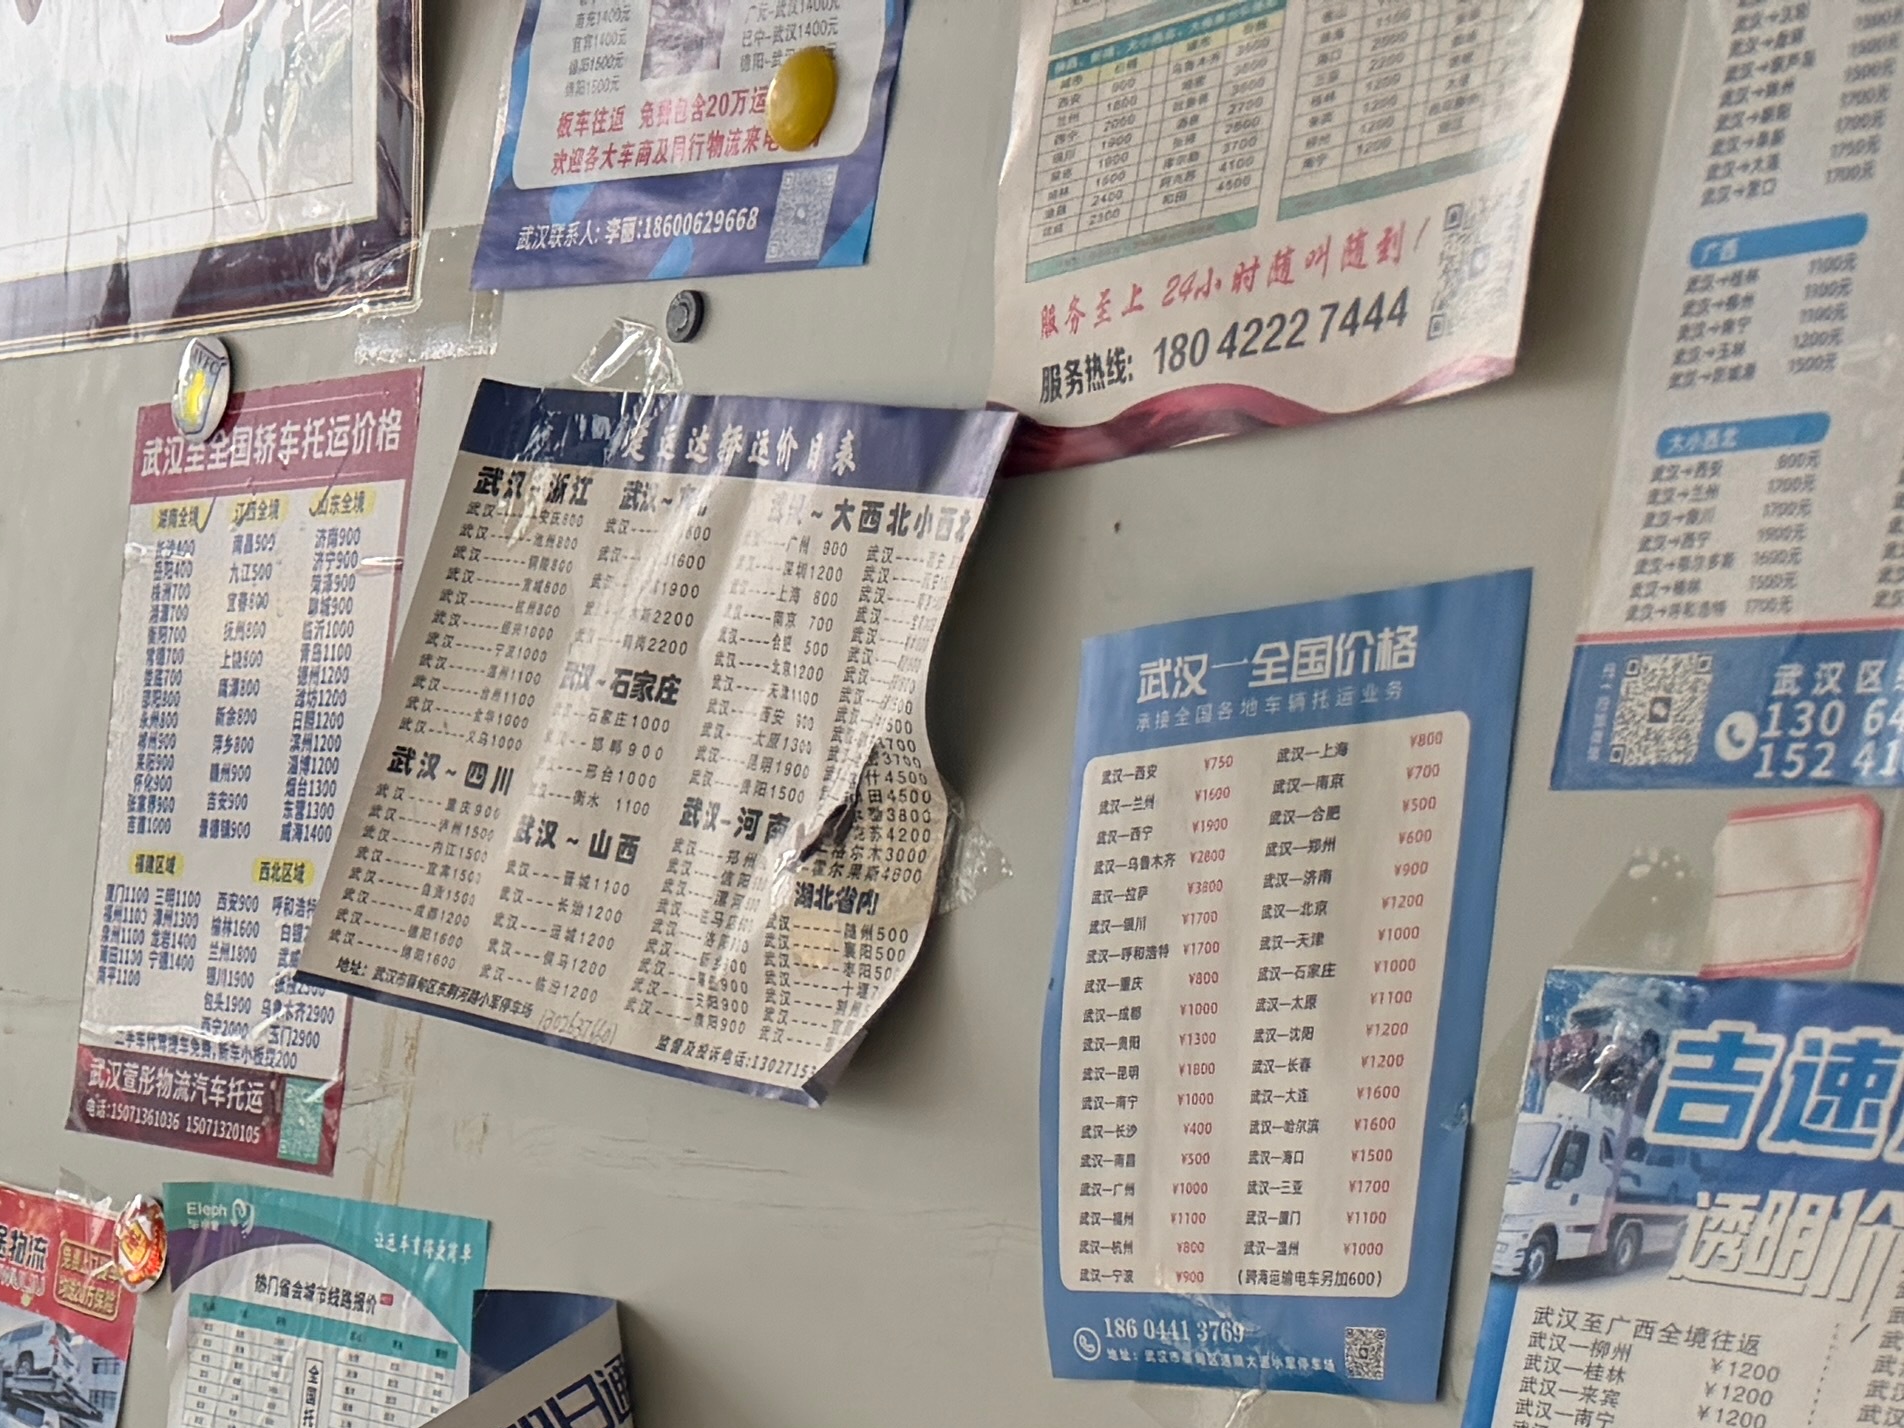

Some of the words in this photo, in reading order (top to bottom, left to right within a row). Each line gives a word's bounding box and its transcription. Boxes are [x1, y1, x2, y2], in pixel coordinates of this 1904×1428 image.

[638, 83, 773, 130] 免费包含20万运
[1154, 328, 1209, 374] 180
[1217, 306, 1319, 362] 4222
[1321, 287, 1410, 340] 7444
[1136, 680, 1404, 732] 承接全国各地车辆托运业务
[1759, 702, 1846, 738] 130
[1410, 731, 1444, 748] ¥800
[1754, 743, 1834, 779] 152
[1406, 764, 1440, 780] ¥700
[1402, 796, 1437, 813] ¥500
[1398, 828, 1433, 845] ¥600
[1394, 861, 1429, 878] ¥900
[1381, 894, 1424, 910] ¥1200
[1377, 926, 1420, 942] ¥1000
[1374, 958, 1416, 974] ¥1000
[1365, 1021, 1408, 1038] ¥1200
[1361, 1053, 1404, 1069] ¥1200
[1357, 1085, 1400, 1101] ¥1600
[186, 1114, 260, 1144] 15071320105
[1353, 1117, 1396, 1132] ¥1600
[1103, 1318, 1138, 1339] 186
[1143, 1319, 1189, 1342] 0441
[1195, 1322, 1245, 1345] 3769
[1532, 1305, 1763, 1358] 武汉至广西全境往返
